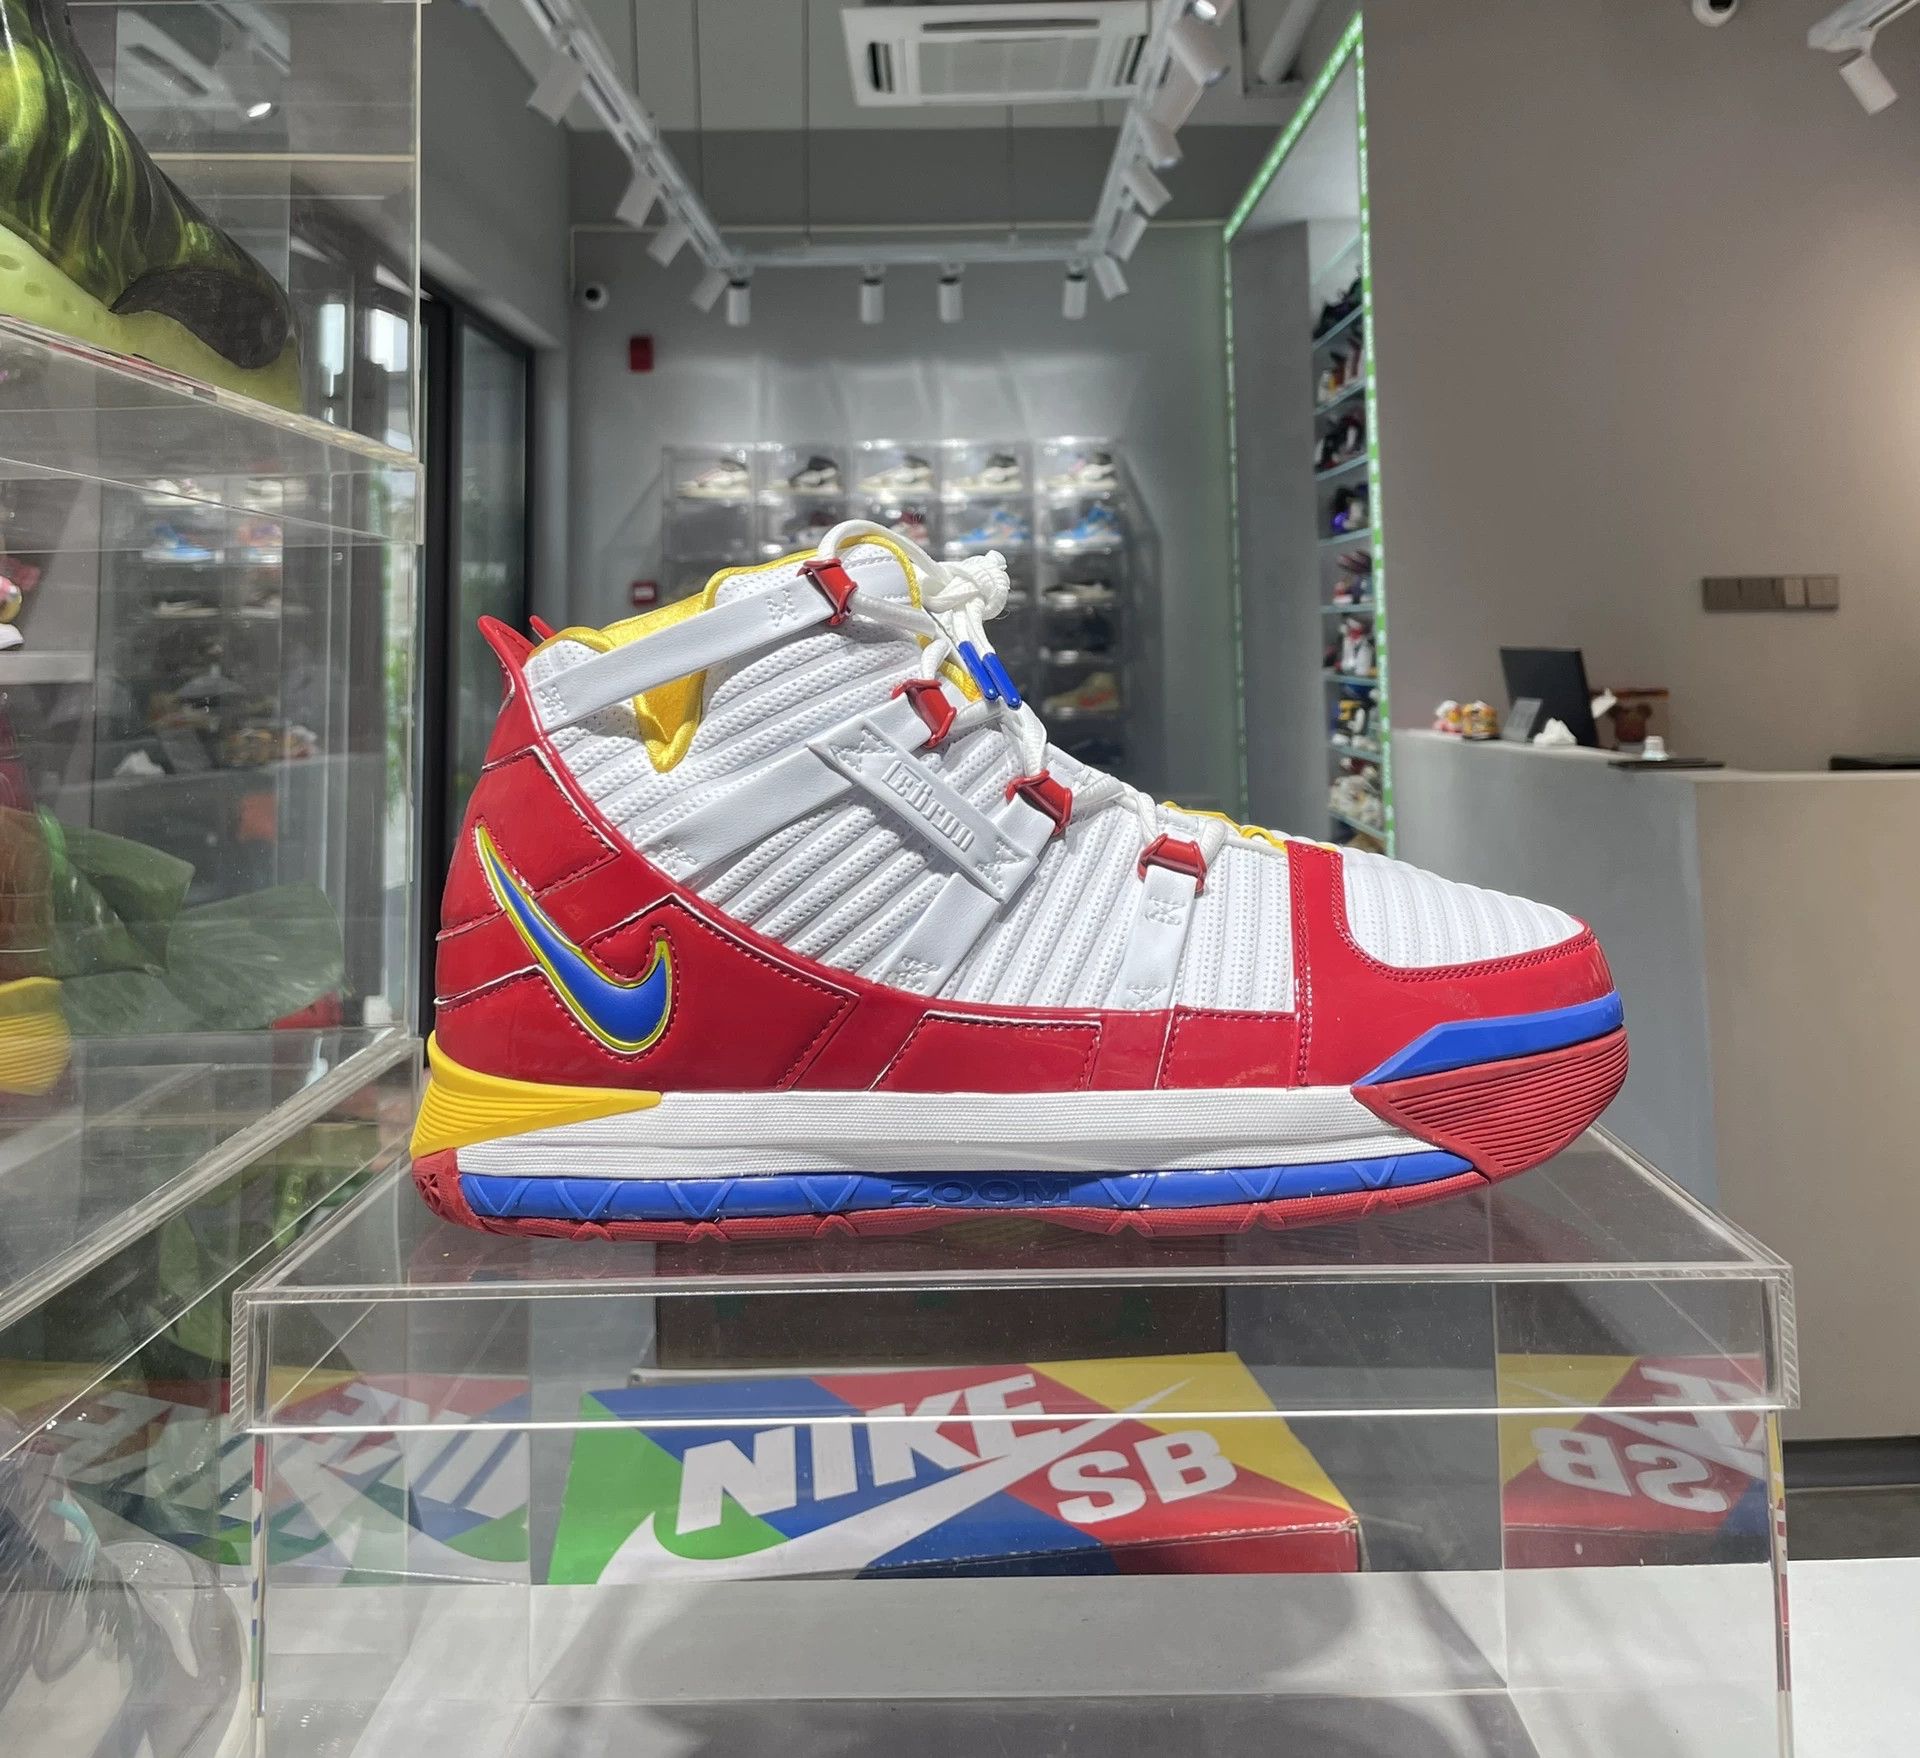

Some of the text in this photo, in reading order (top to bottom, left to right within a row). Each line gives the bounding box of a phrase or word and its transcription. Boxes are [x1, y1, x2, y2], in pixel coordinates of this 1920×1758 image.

[890, 1178, 1071, 1205] ZOOM
[675, 1373, 1063, 1535] NIKE
[1047, 1430, 1238, 1524] SB
